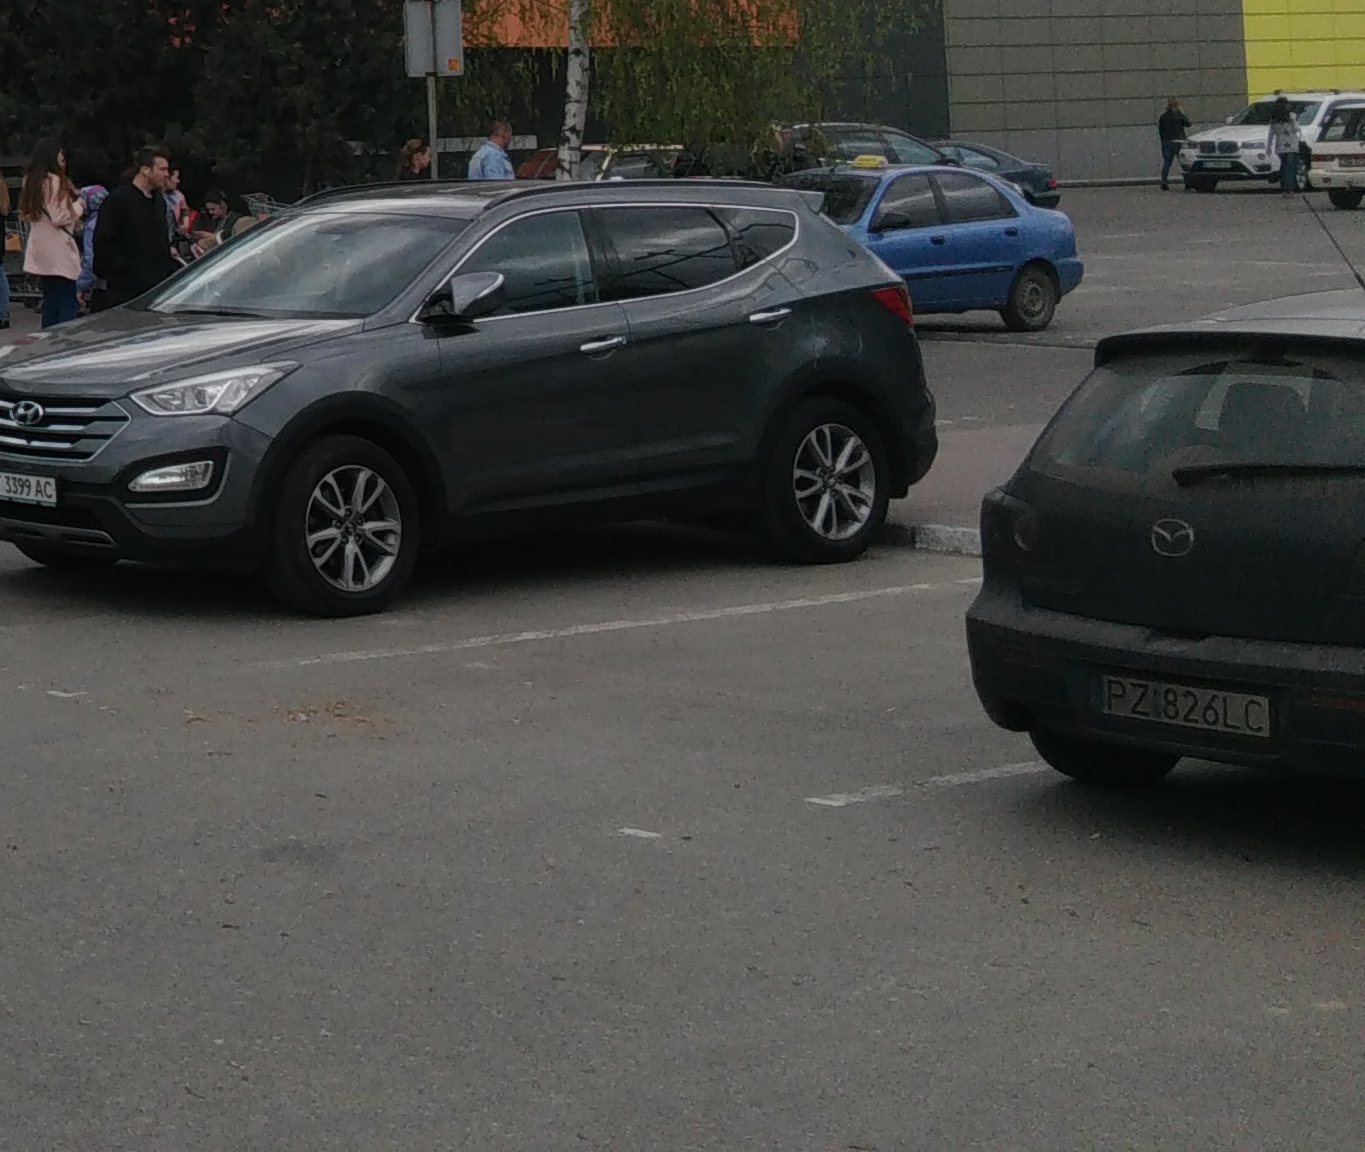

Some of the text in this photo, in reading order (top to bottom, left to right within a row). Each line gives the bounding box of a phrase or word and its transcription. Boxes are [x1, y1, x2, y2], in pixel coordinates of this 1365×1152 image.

[5, 475, 31, 496] 3399
[35, 479, 53, 499] AC
[1107, 679, 1263, 732] PZ 826LC
